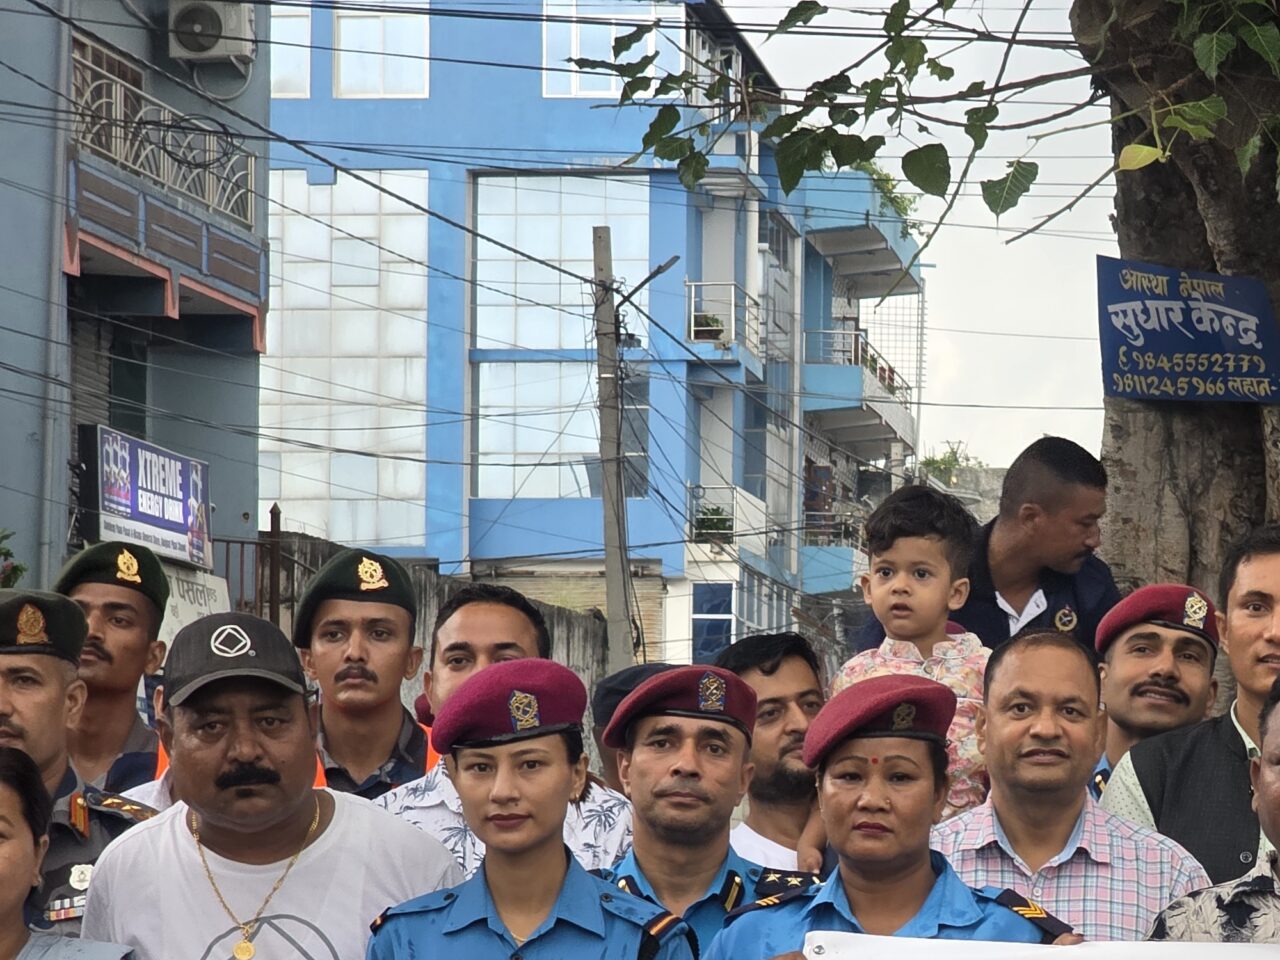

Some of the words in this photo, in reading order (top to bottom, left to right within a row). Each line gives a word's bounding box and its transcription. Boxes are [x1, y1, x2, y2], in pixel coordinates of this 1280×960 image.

[1118, 268, 1169, 297] आस्था
[1107, 300, 1195, 347] सुधार
[1188, 294, 1263, 349] केन्द्र
[137, 448, 183, 501] XTREME
[138, 489, 163, 519] ENERGY
